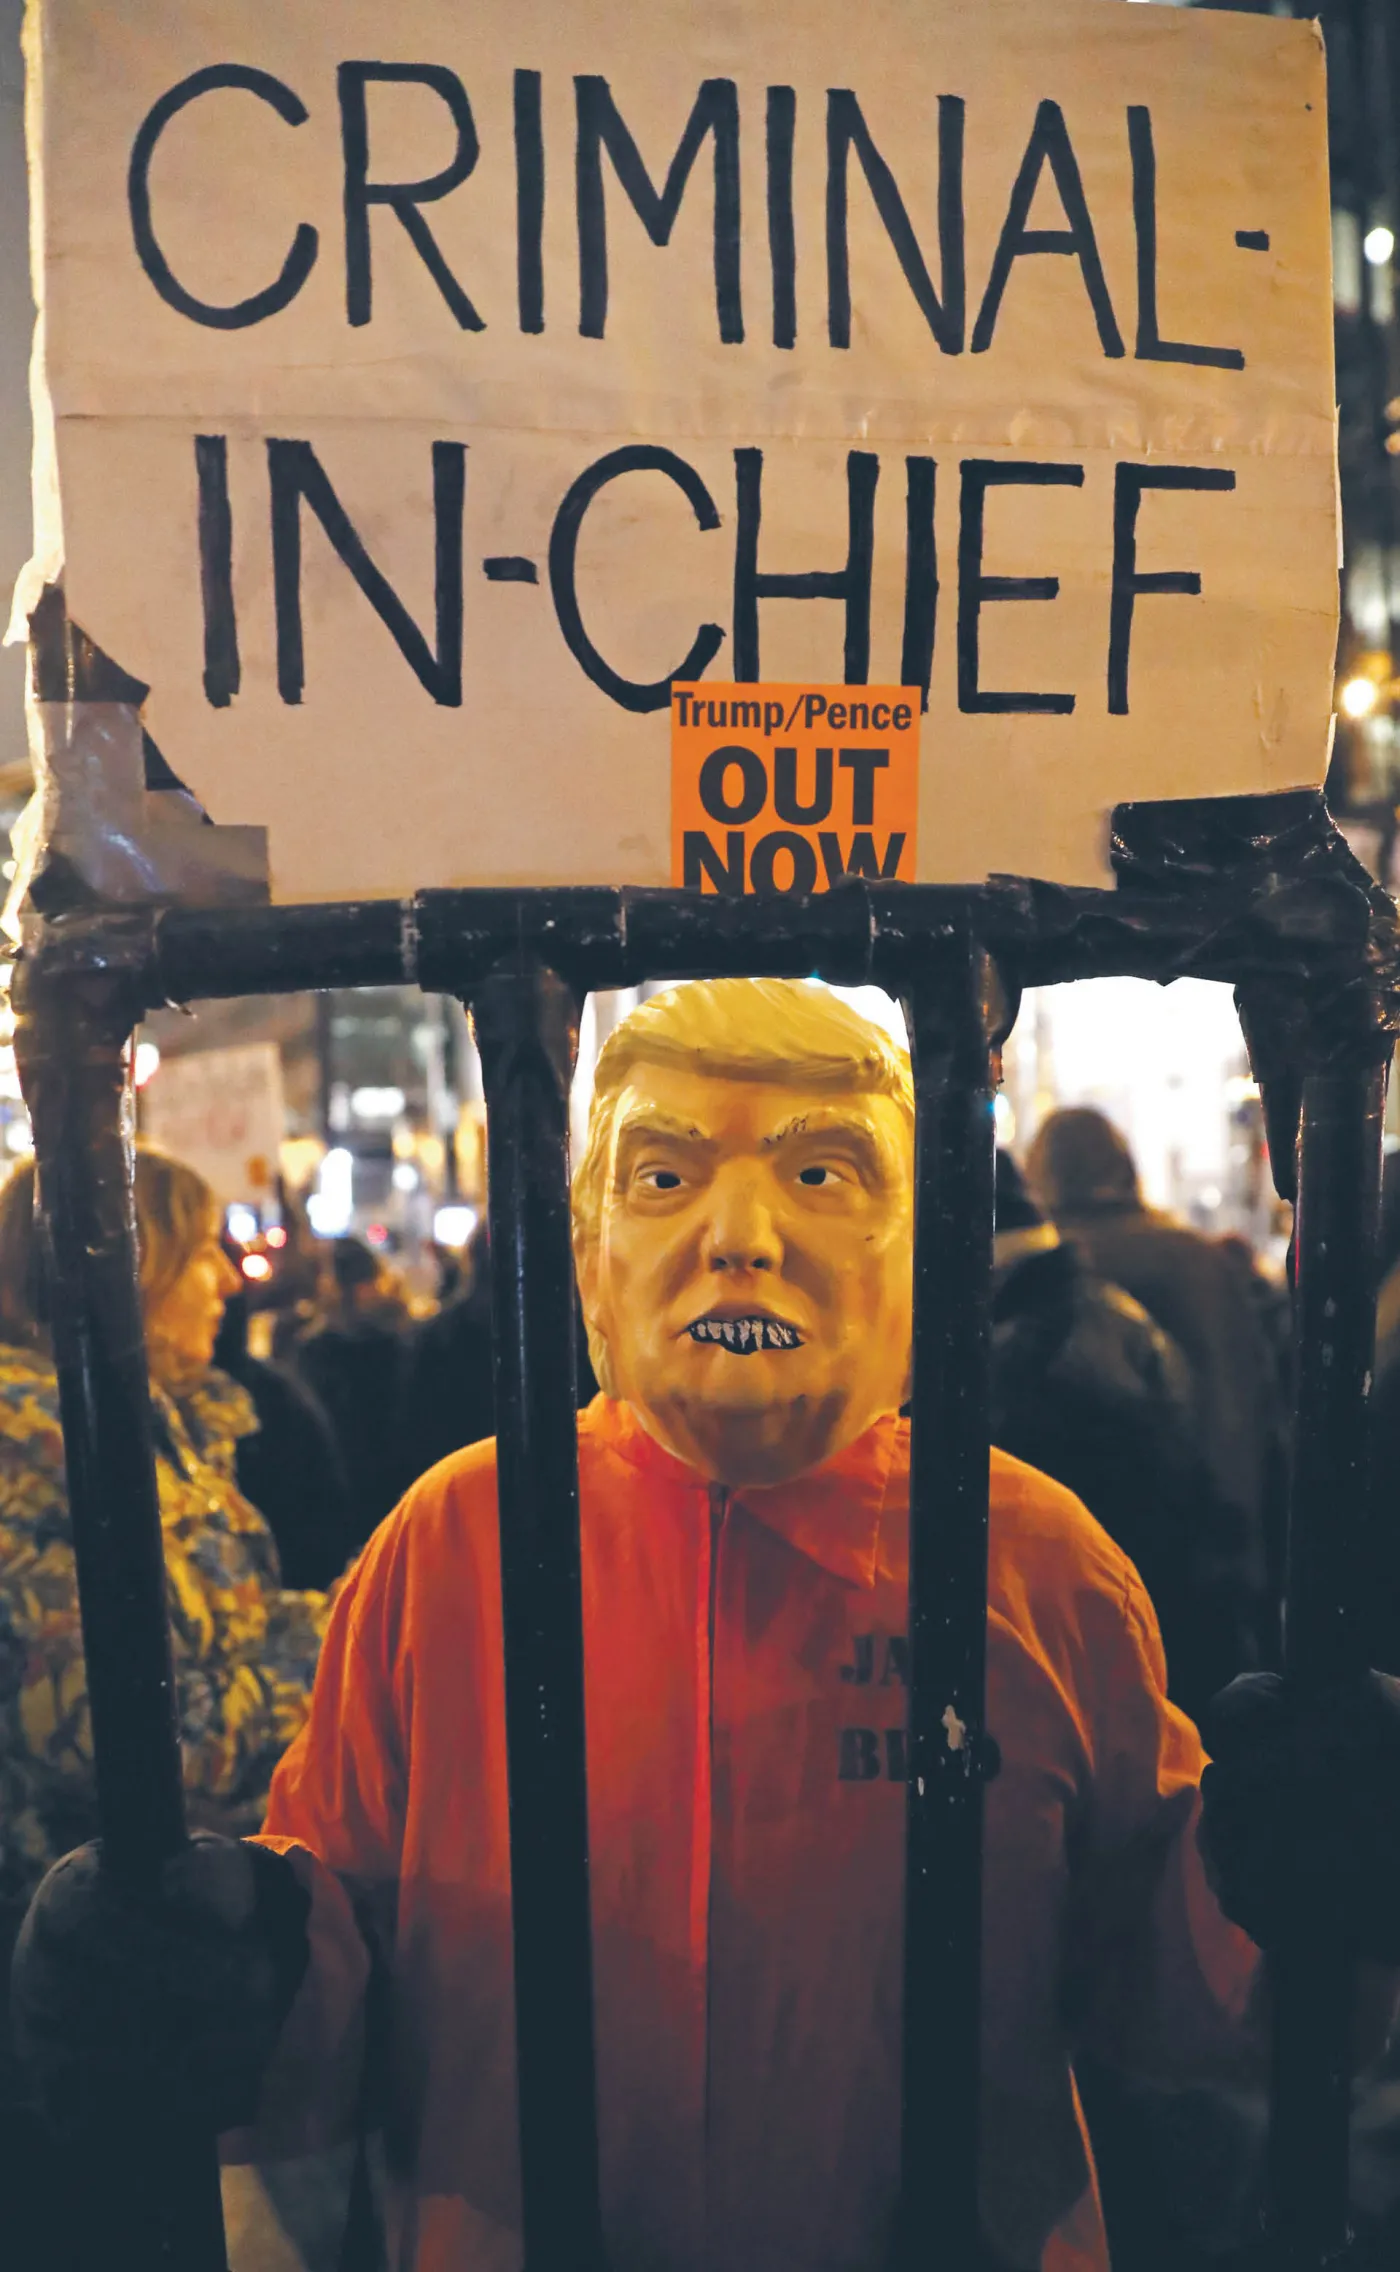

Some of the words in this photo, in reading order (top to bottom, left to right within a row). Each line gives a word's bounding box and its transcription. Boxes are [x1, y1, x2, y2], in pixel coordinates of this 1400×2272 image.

[128, 60, 1269, 371] CRIMINAL-
[195, 435, 1236, 716] IN-CHIEF
[673, 691, 912, 736] Trump/Pence
[698, 745, 889, 826] OUT
[683, 830, 906, 895] NOW
